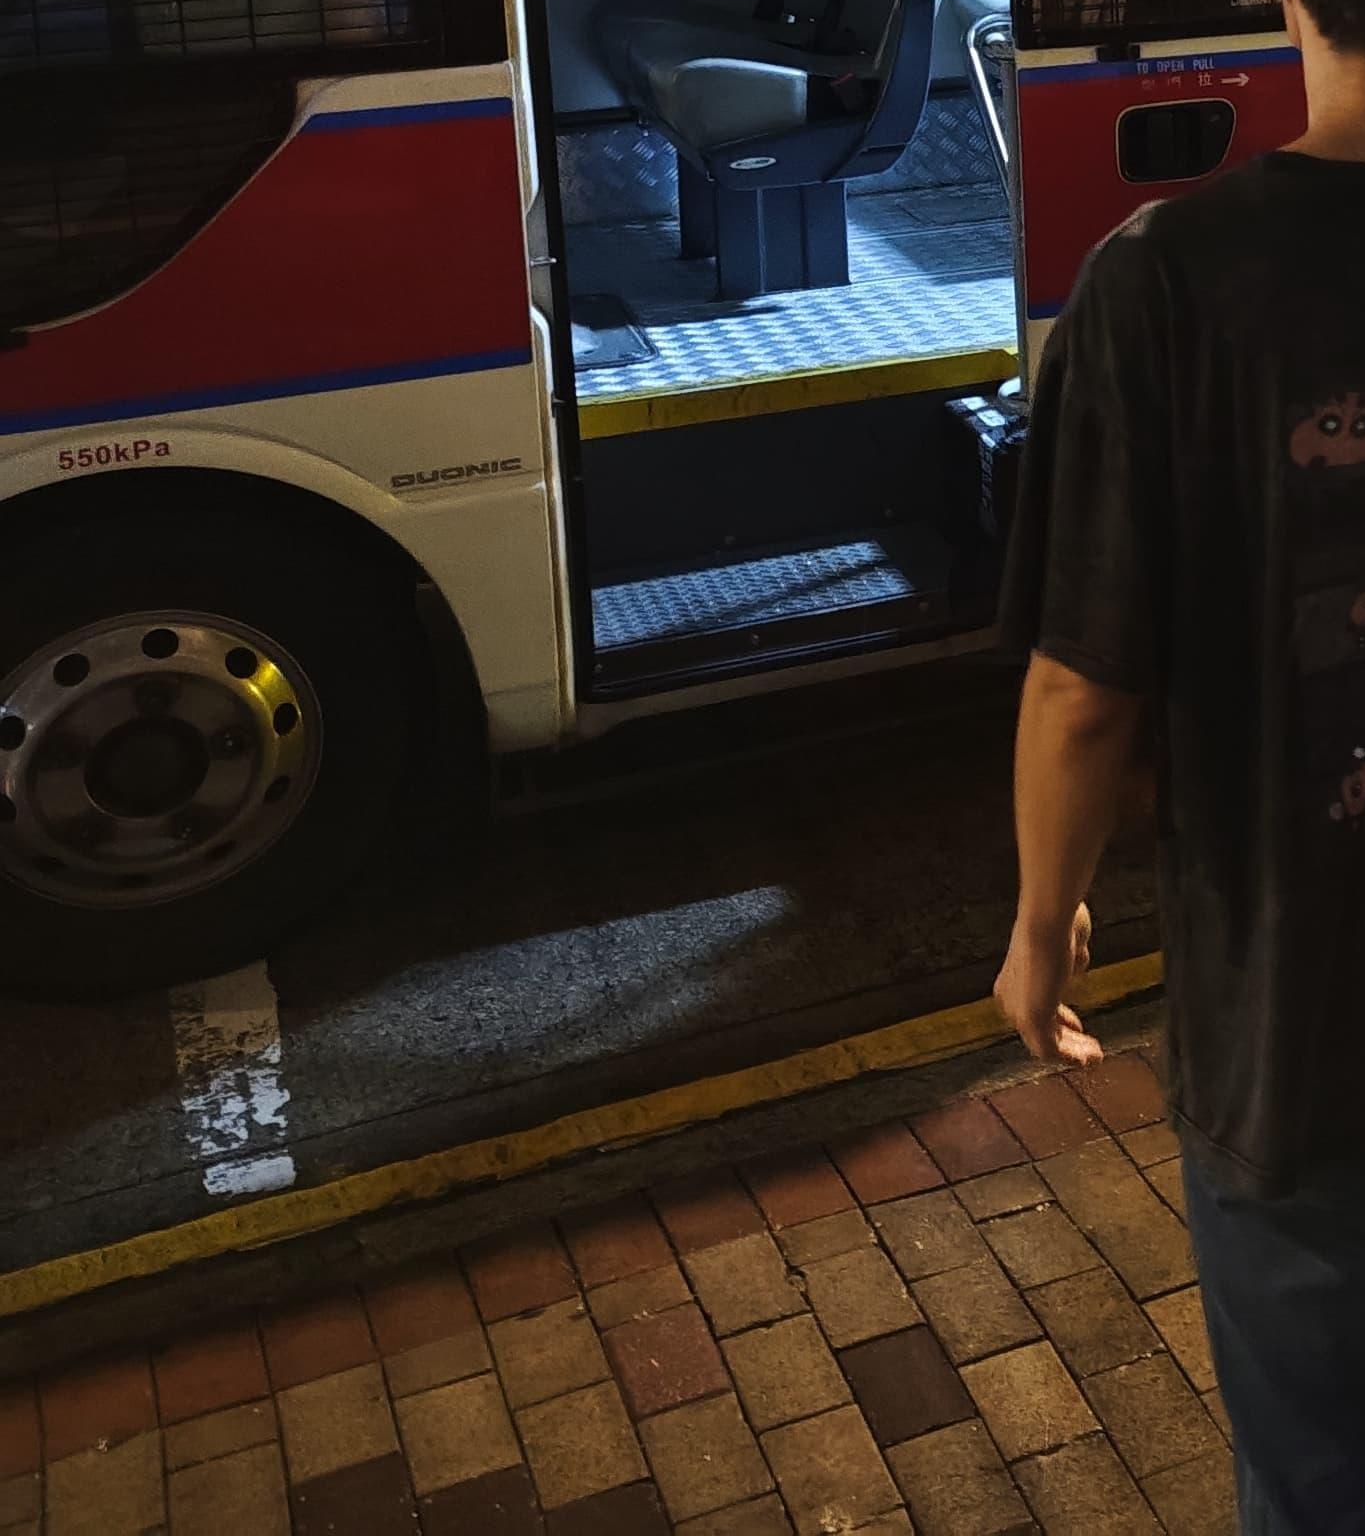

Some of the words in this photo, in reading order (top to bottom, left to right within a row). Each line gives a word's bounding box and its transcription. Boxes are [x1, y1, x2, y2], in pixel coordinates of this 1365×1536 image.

[1137, 63, 1149, 74] TO
[1157, 60, 1185, 73] OPEN
[1193, 57, 1215, 70] PULL
[57, 439, 171, 471] 550kPa
[389, 456, 523, 490] DUONIC
